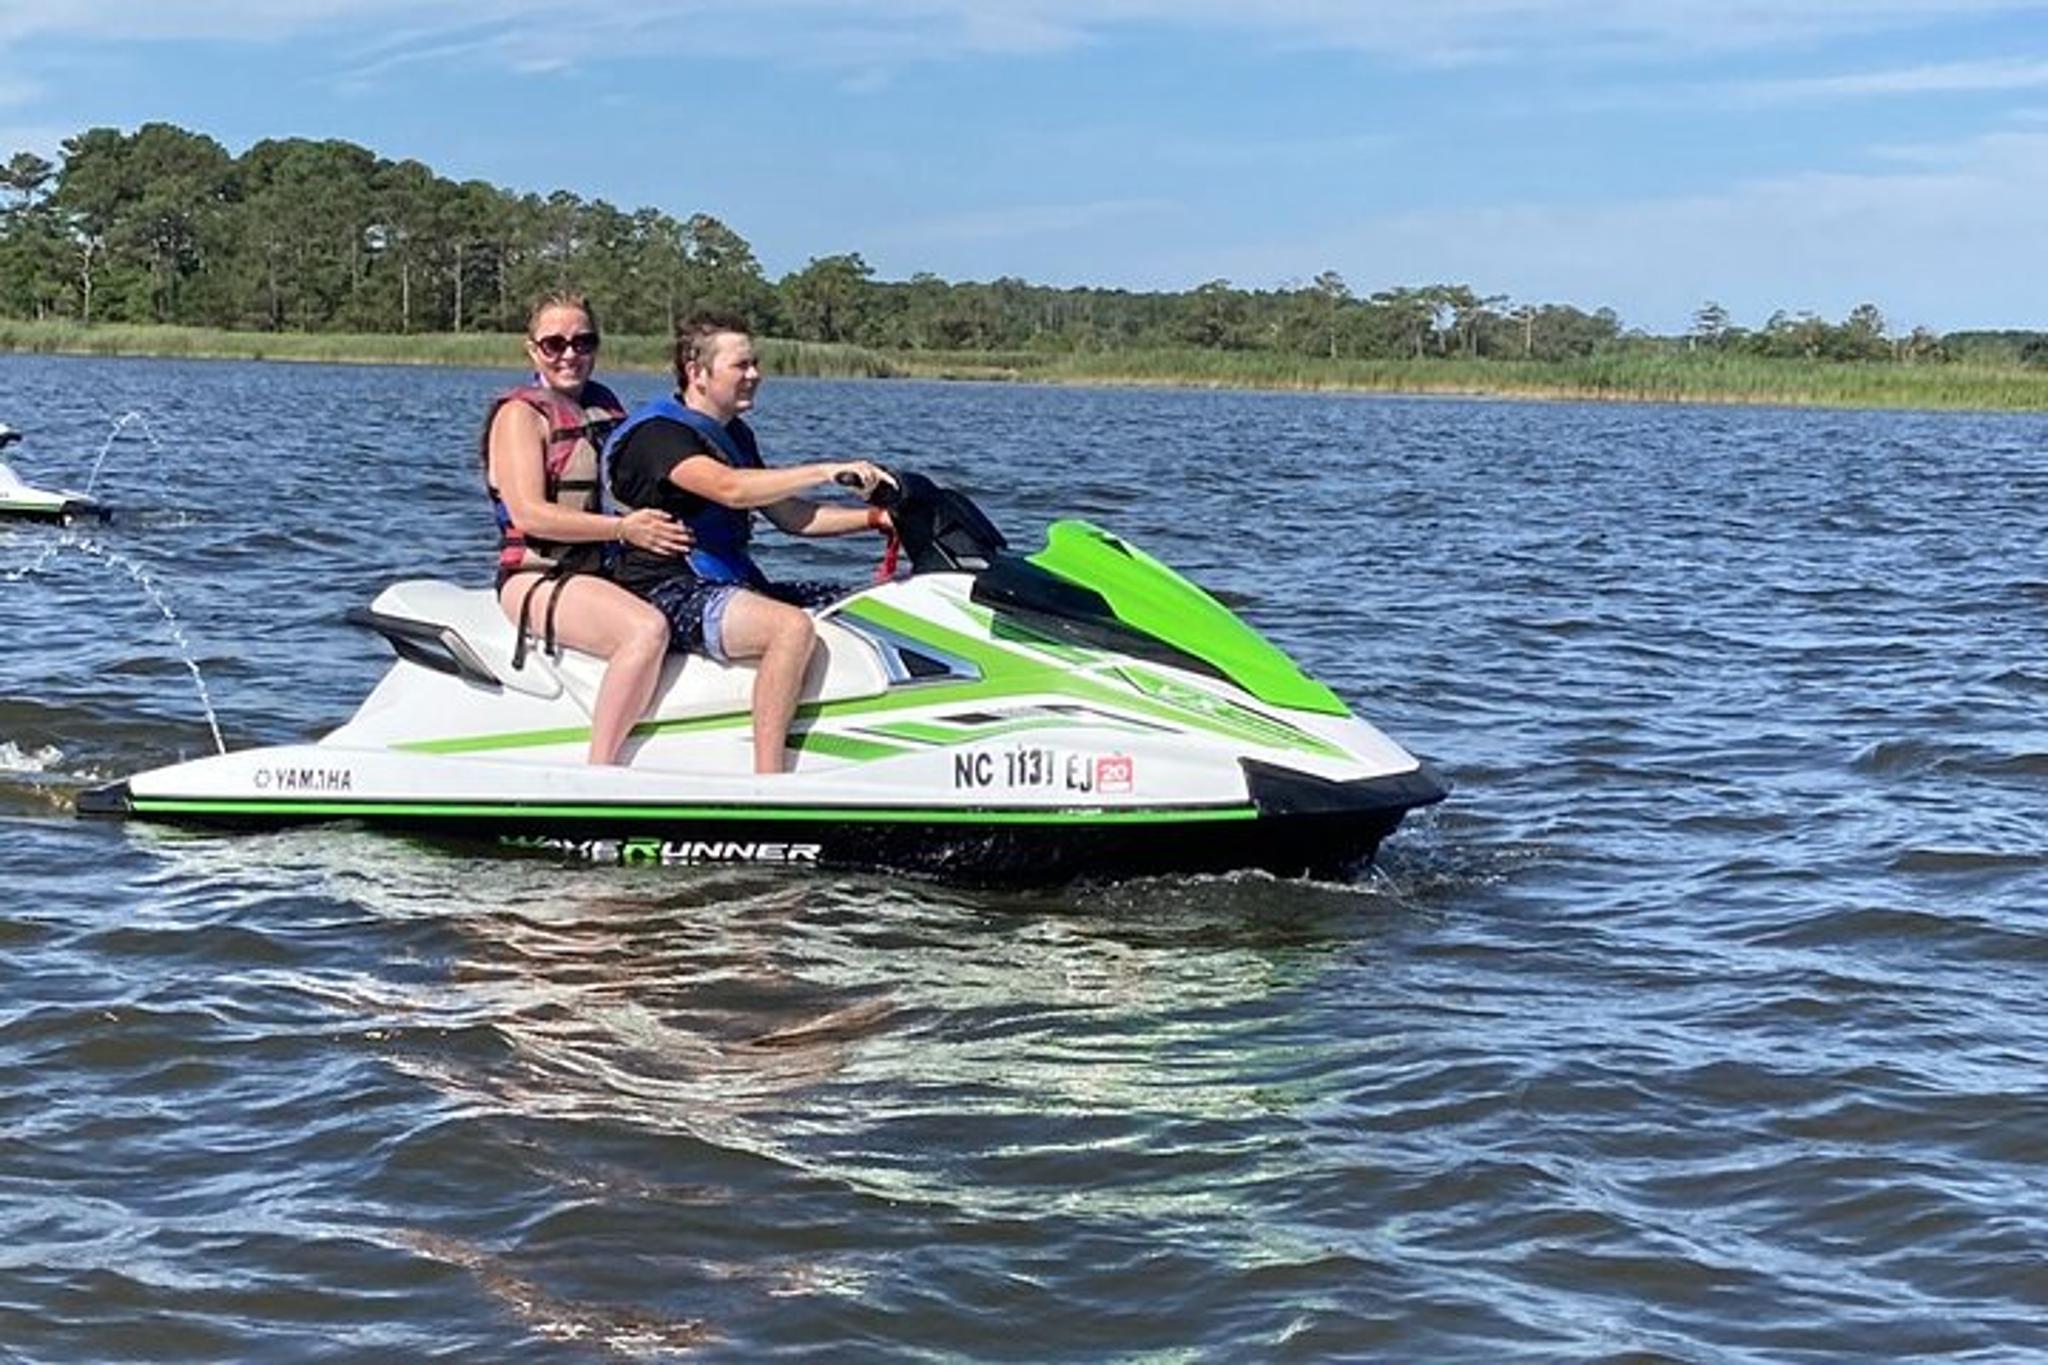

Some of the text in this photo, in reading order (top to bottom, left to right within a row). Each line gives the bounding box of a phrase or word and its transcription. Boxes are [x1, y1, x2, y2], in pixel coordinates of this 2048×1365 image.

[275, 768, 352, 790] YAMAHA
[954, 752, 993, 788] NC
[1066, 754, 1093, 793] EJ
[1100, 764, 1127, 781] 20
